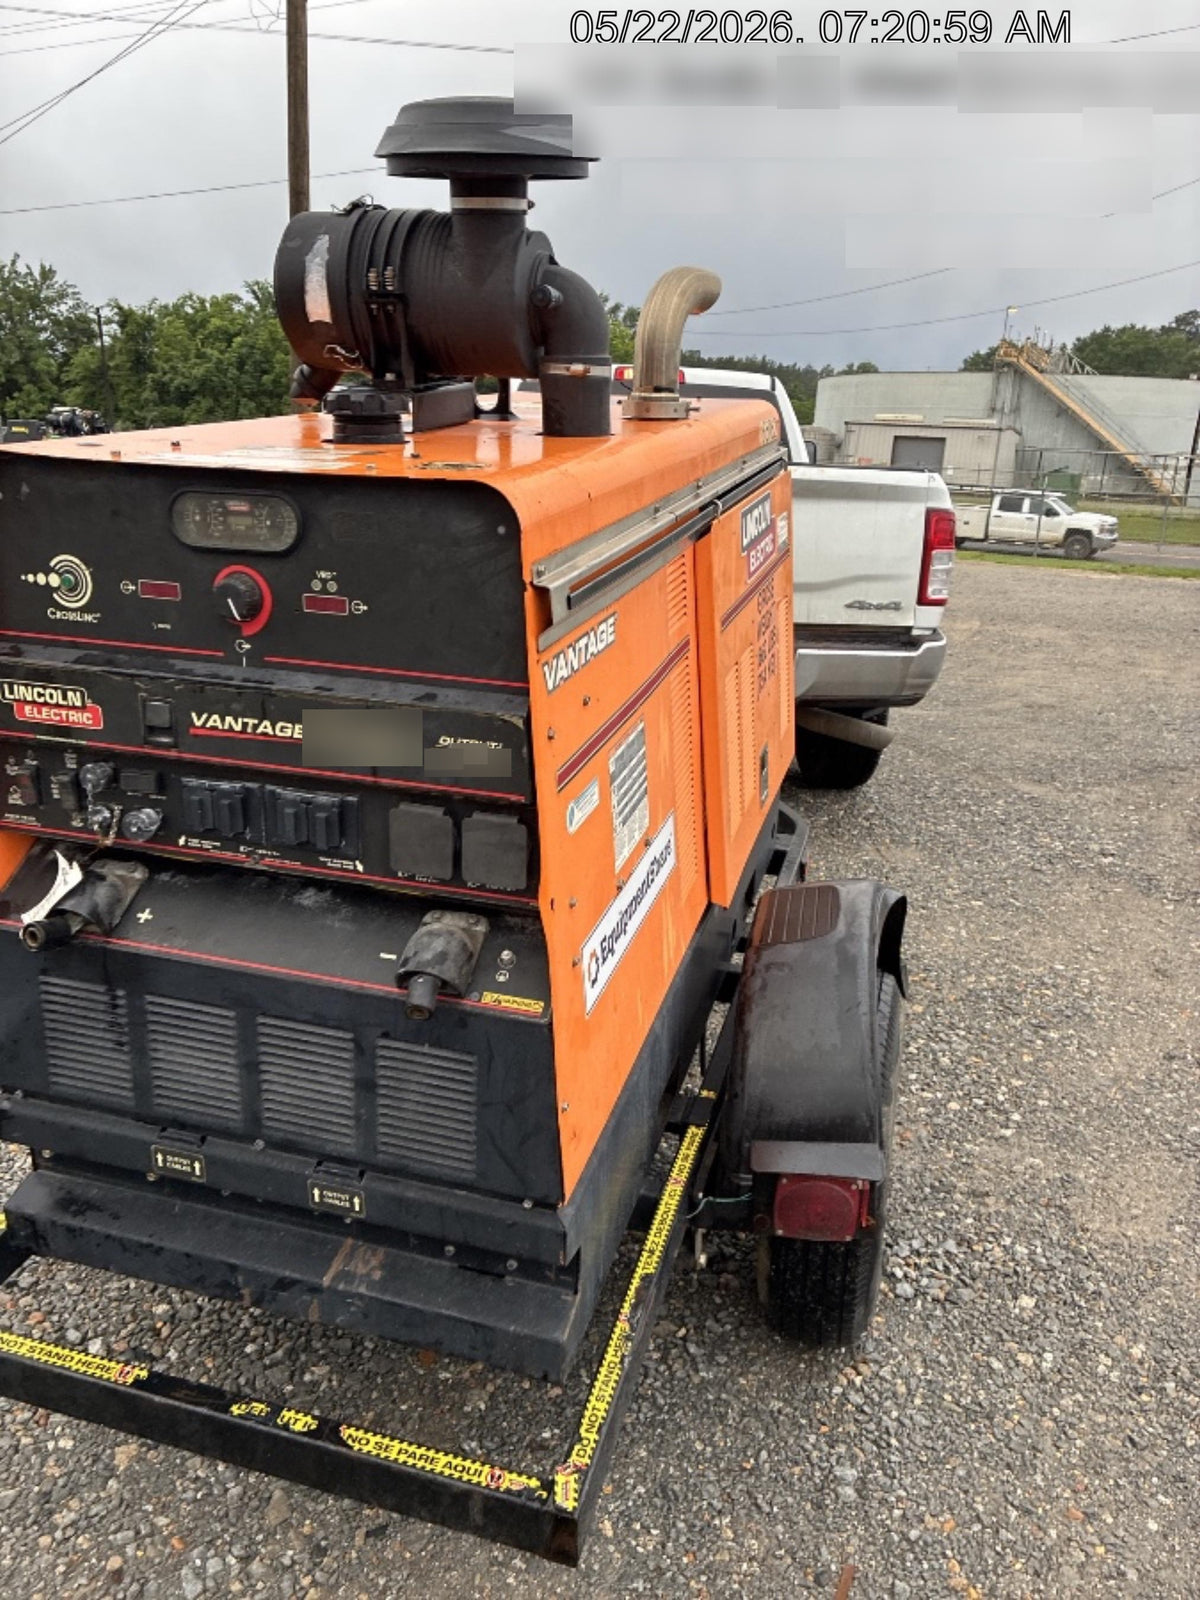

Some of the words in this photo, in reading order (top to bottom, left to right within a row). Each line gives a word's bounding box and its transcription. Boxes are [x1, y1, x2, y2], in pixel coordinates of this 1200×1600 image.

[543, 612, 617, 691] VANTAGE
[3, 683, 82, 707] LINCOLN
[24, 705, 93, 725] ELECTRIC
[191, 711, 303, 738] VANTAGE
[26, 1345, 76, 1363] STAND
[75, 1357, 117, 1375] HERE
[576, 1437, 591, 1459] DO
[586, 1406, 602, 1435] NOT
[595, 1359, 618, 1404] STAND
[613, 1326, 628, 1358] HERE
[345, 1432, 370, 1447] NO
[374, 1440, 395, 1453] SE
[396, 1446, 440, 1467] PARE
[442, 1460, 483, 1479] AQUI
